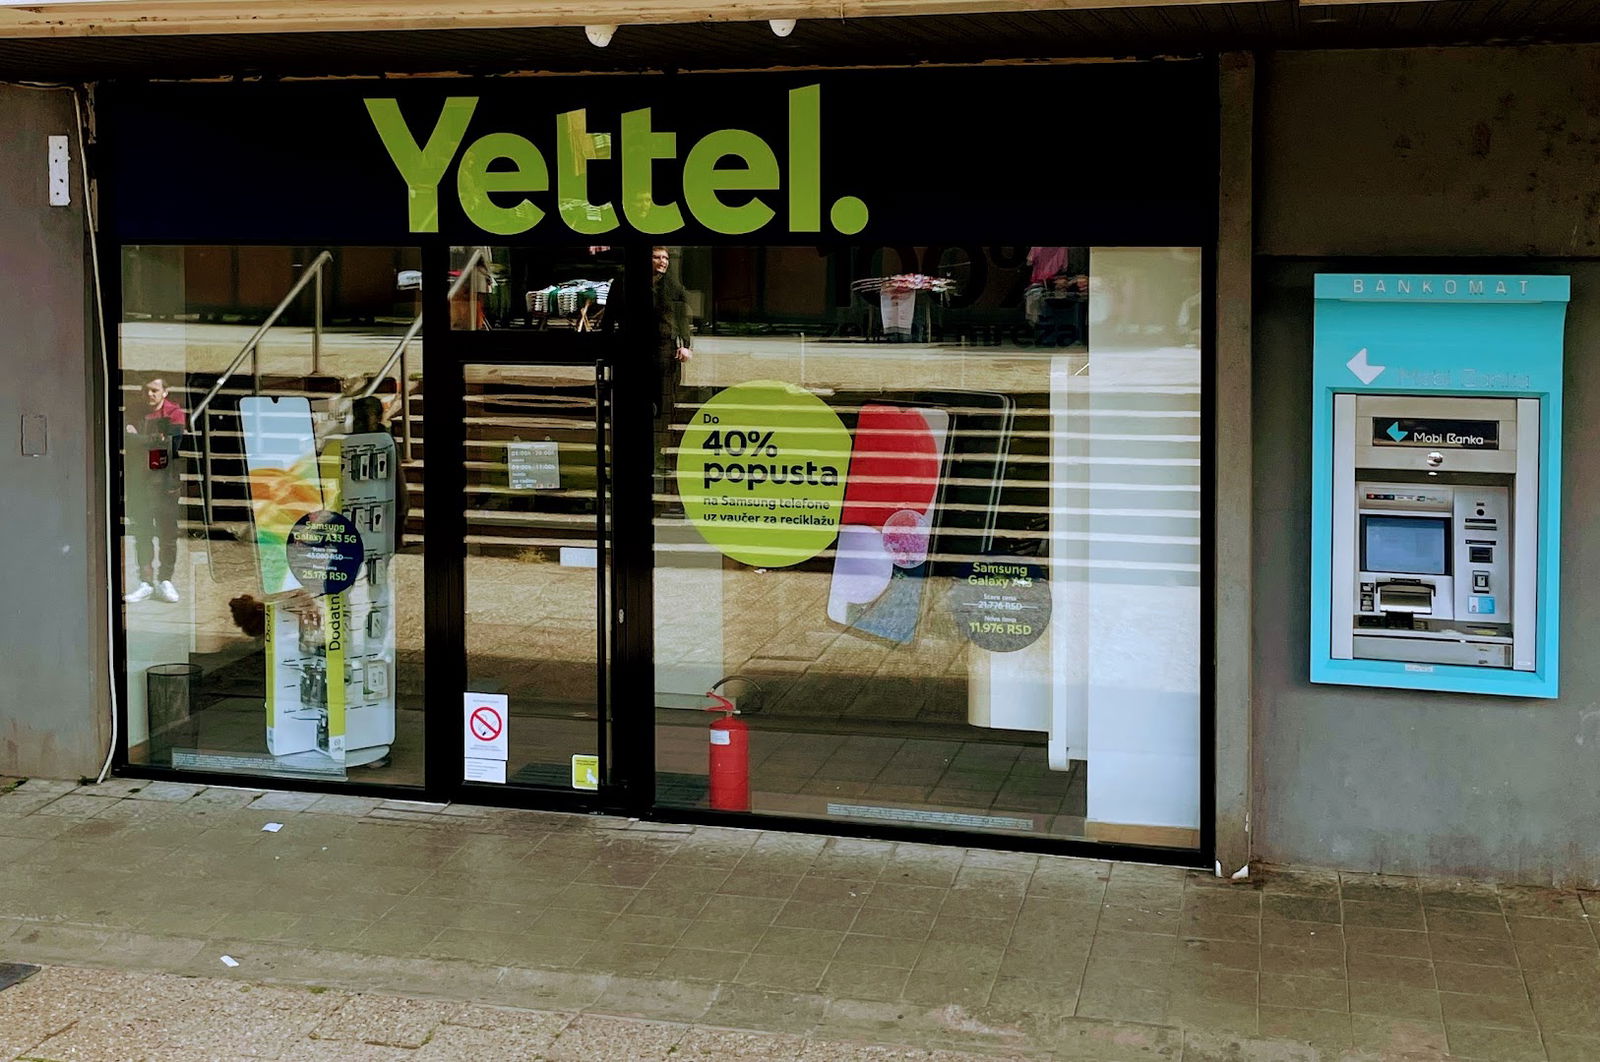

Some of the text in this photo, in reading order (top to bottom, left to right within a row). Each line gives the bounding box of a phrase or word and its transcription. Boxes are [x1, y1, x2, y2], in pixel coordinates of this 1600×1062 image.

[362, 84, 869, 235] Yettel.
[1353, 279, 1529, 295] BANKOMAT
[703, 413, 720, 424] Do
[702, 430, 778, 458] 40%
[1413, 432, 1484, 445] Mobi Banka
[704, 461, 838, 490] popusta
[703, 496, 830, 510] na Samsung telefone
[703, 513, 835, 526] uz vaučer za reciklažu
[305, 521, 345, 533] Samsung
[293, 532, 357, 543] Galaxy A33 5G
[329, 572, 348, 581] RSD
[972, 562, 1028, 577] Samsung
[968, 575, 1009, 589] Galaxy
[1004, 602, 1023, 611] RSD
[264, 604, 272, 643] Doda
[328, 596, 341, 651] Dodatn
[968, 622, 1032, 635] 11.976 RSD
